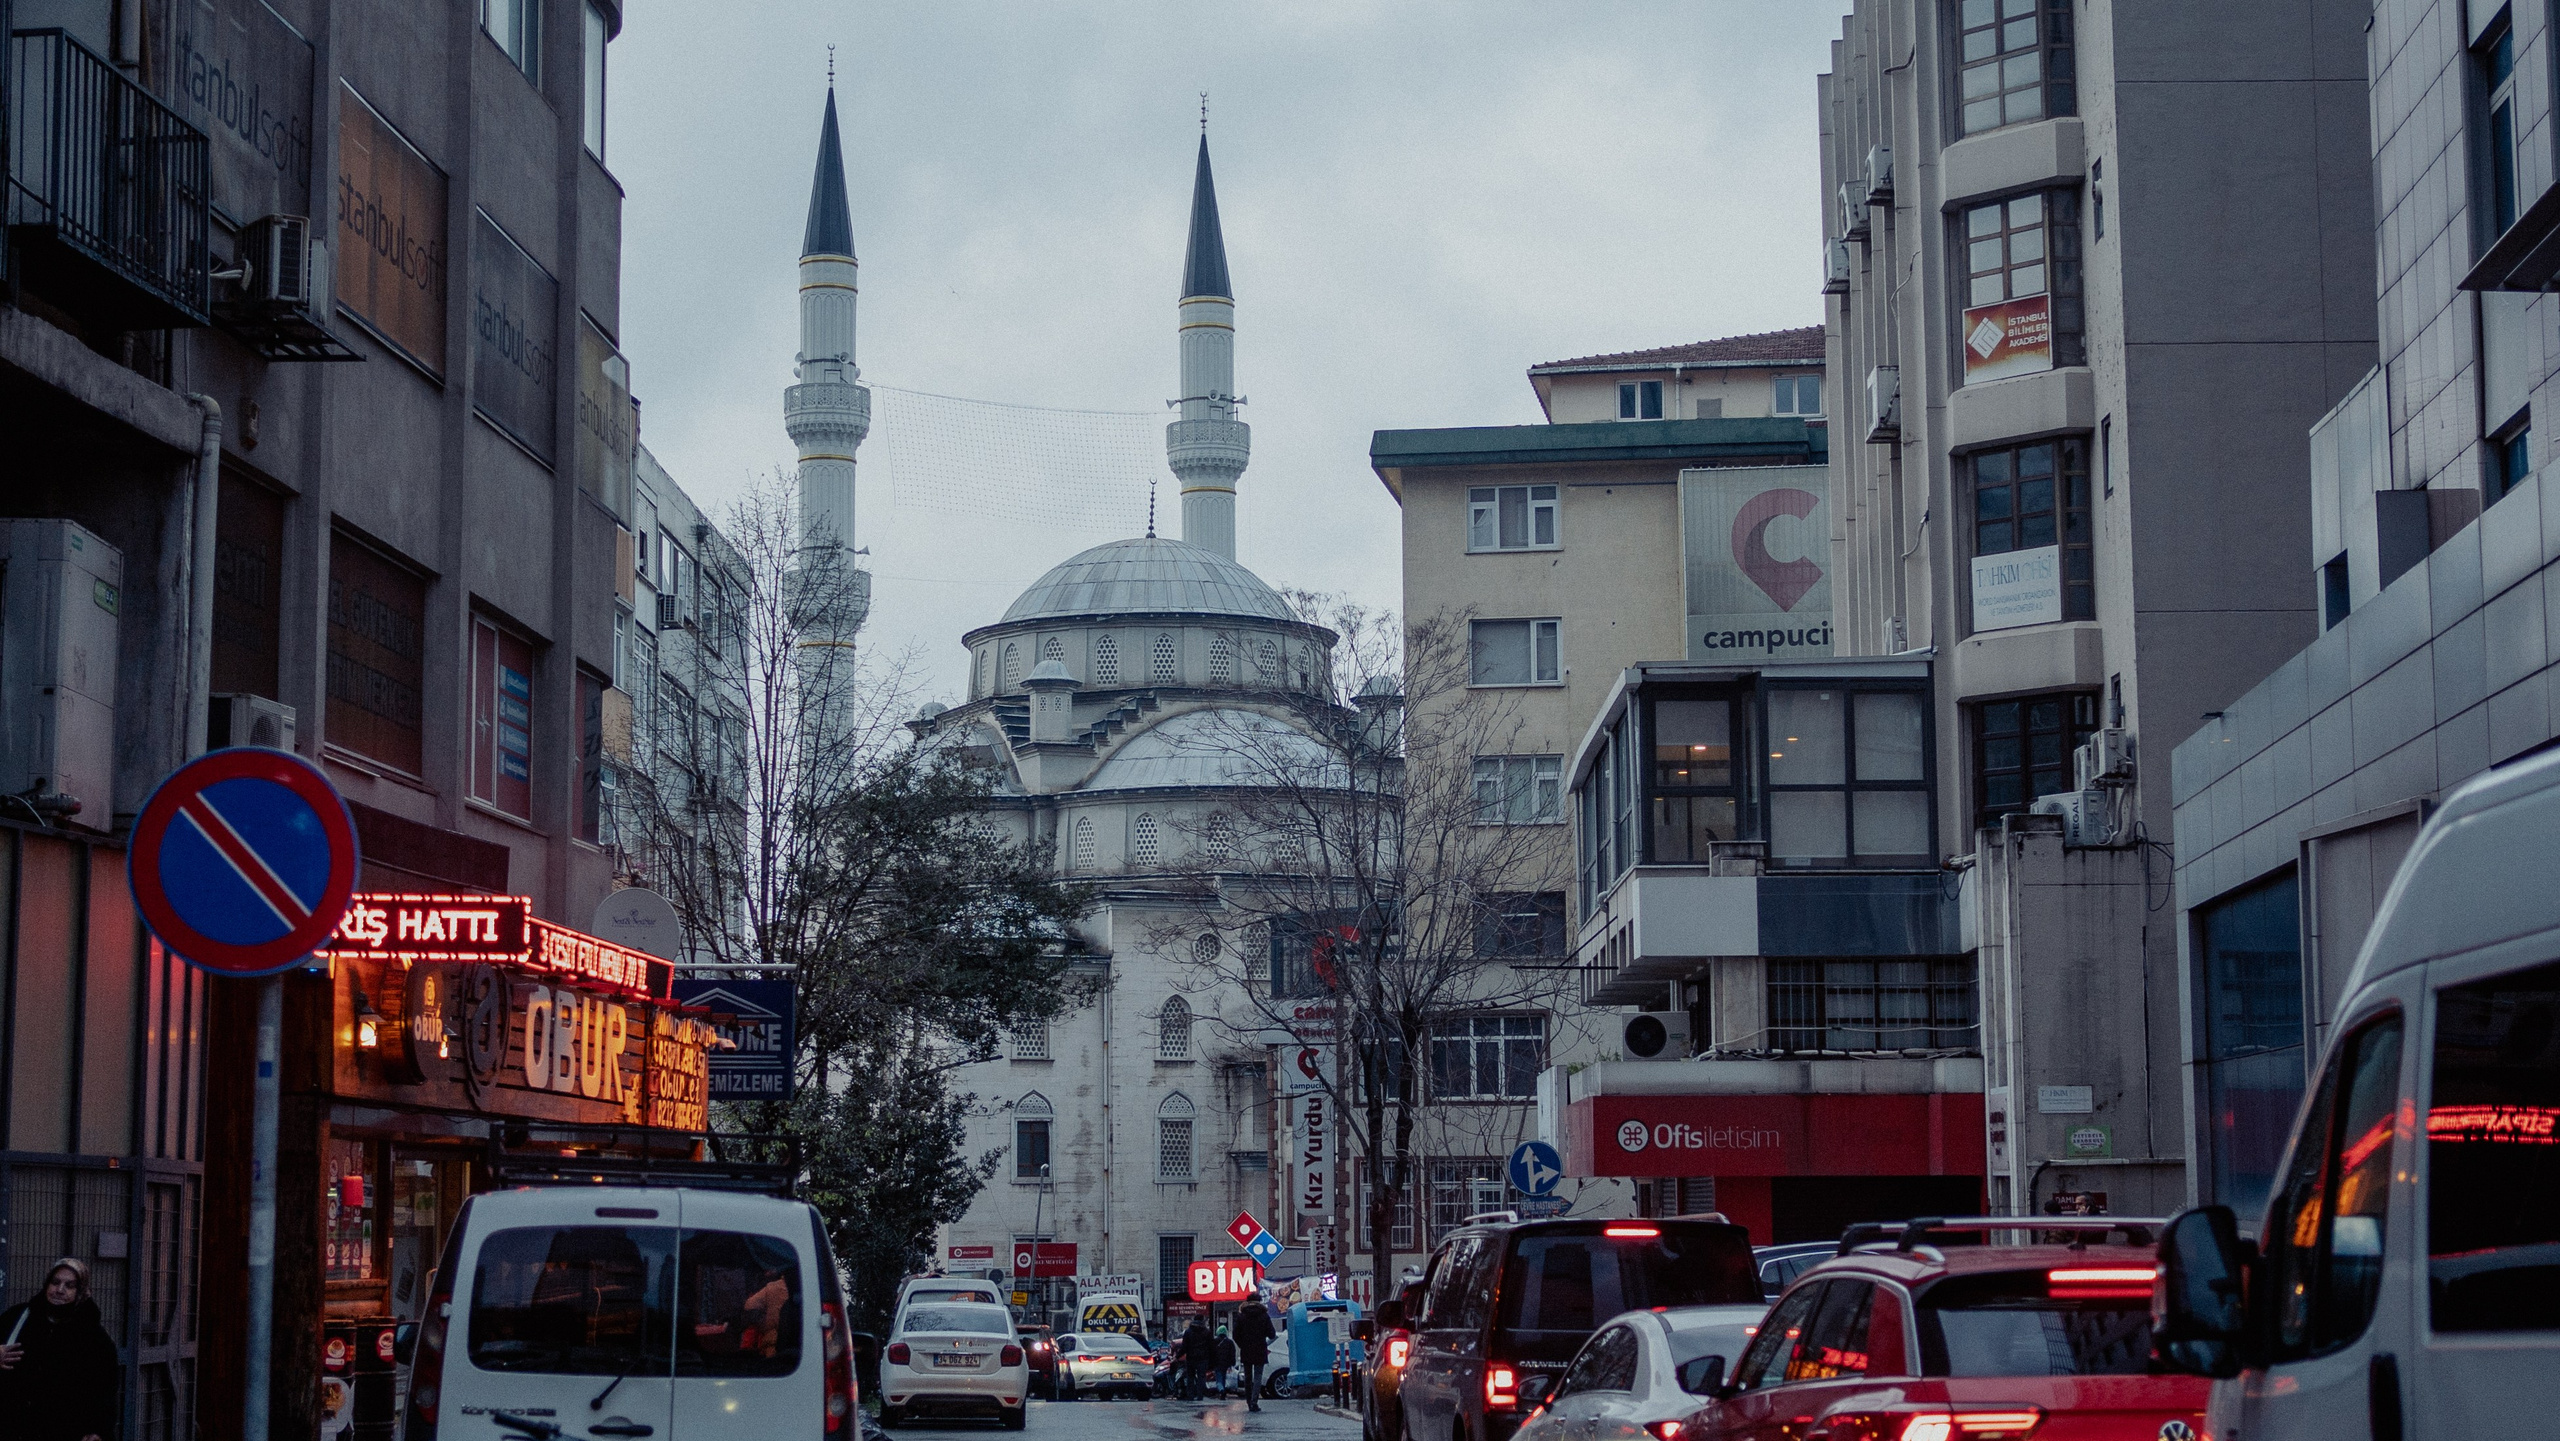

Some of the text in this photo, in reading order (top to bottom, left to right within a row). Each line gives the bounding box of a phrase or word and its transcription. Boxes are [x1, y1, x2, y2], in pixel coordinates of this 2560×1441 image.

[177, 31, 307, 188] tanbulsoft
[2008, 312, 2047, 326] İSTANBUL
[2008, 323, 2048, 337] BİLİMLER
[474, 286, 552, 394] tanbulsoft
[2009, 332, 2048, 348] AKADEMİSİ
[1703, 620, 1834, 654] campuci
[2072, 799, 2080, 838] REGAL
[398, 909, 500, 942] HATTI
[414, 1015, 443, 1043] OBUR
[525, 984, 627, 1102] OBUR
[1304, 1097, 1323, 1210] Kız Yurdu
[1315, 1228, 1326, 1267] OTOPARK
[1194, 1261, 1257, 1295] BİM
[1087, 1318, 1109, 1326] OKUL
[939, 1354, 947, 1364] 34
[1519, 1360, 1568, 1368] CARAVELLE
